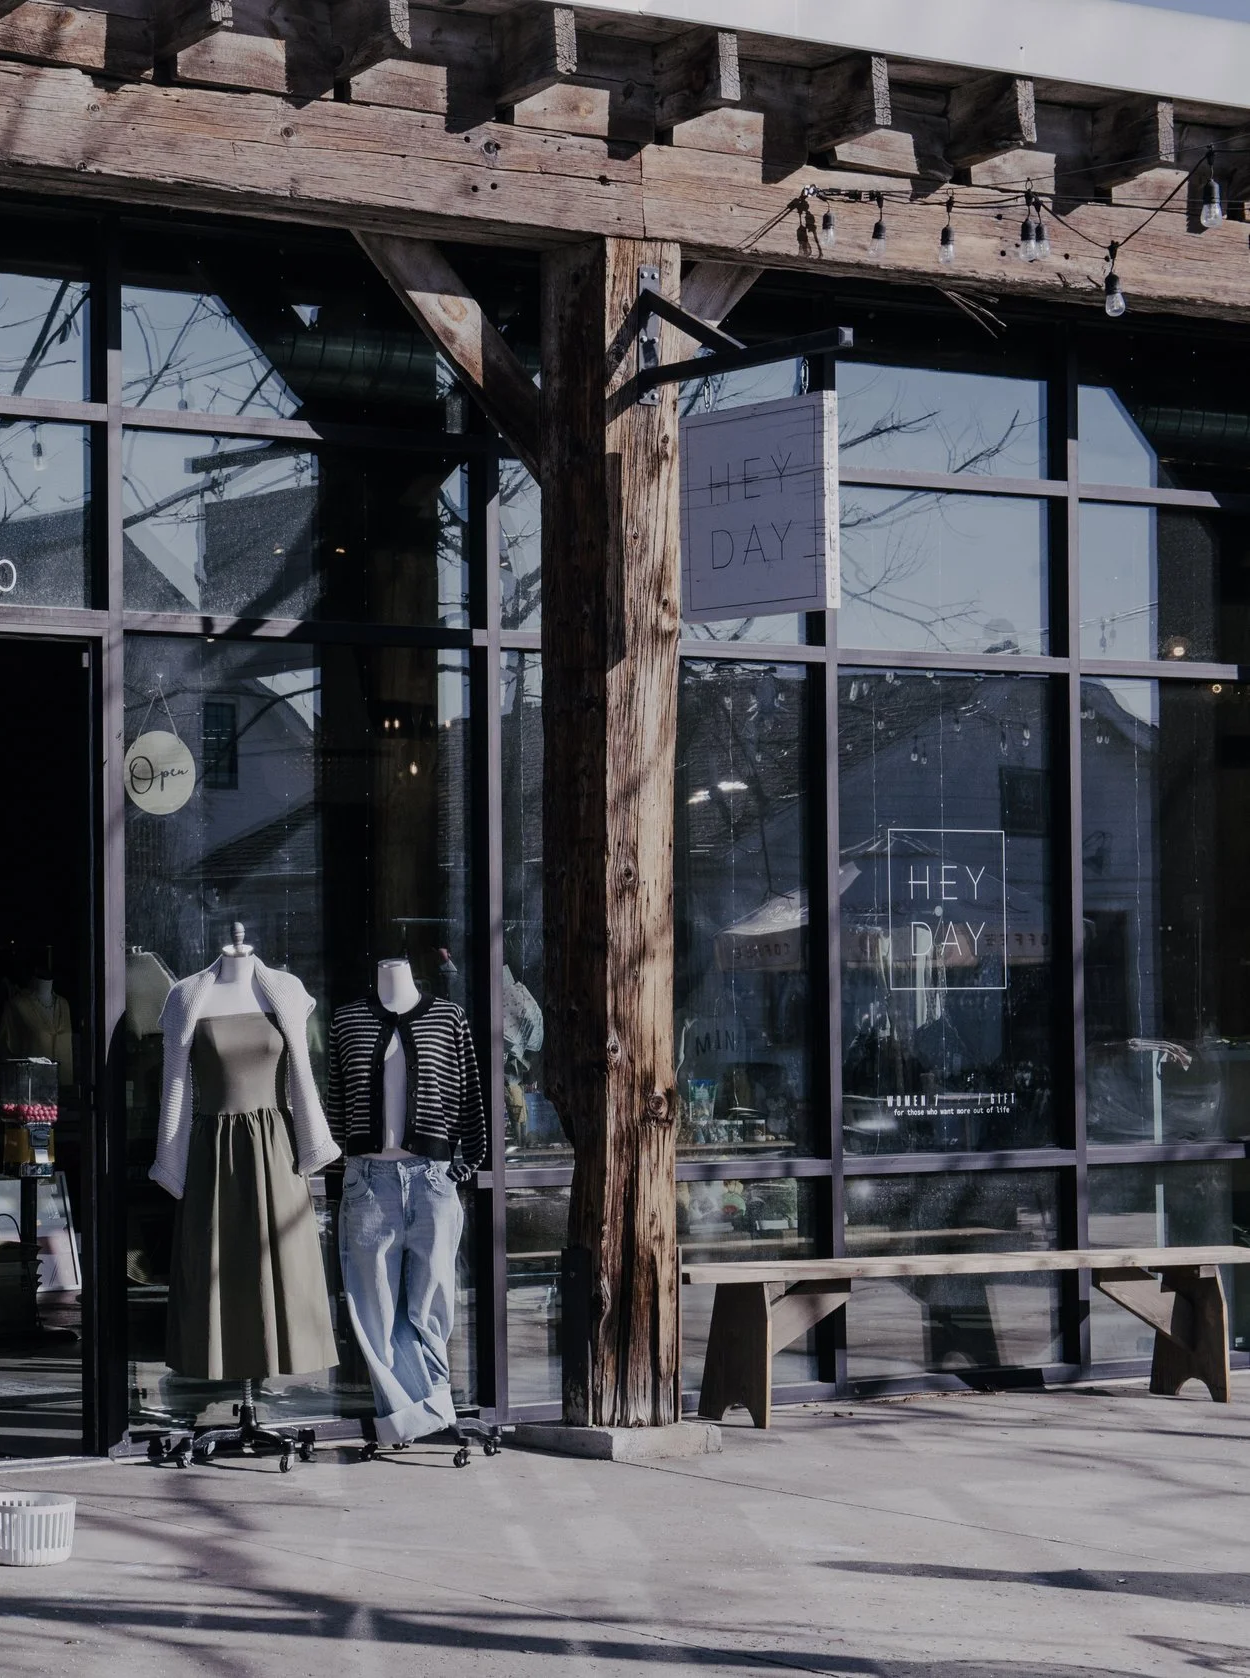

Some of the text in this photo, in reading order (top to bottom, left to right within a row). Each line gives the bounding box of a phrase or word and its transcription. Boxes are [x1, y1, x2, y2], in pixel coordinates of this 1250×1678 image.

[708, 452, 792, 504] HEY
[712, 520, 793, 570] DAY
[128, 756, 190, 795] Open
[908, 865, 986, 900] HEY
[911, 921, 986, 956] DAY
[886, 1094, 926, 1107] WOMEN
[990, 1092, 1015, 1105] GIFT
